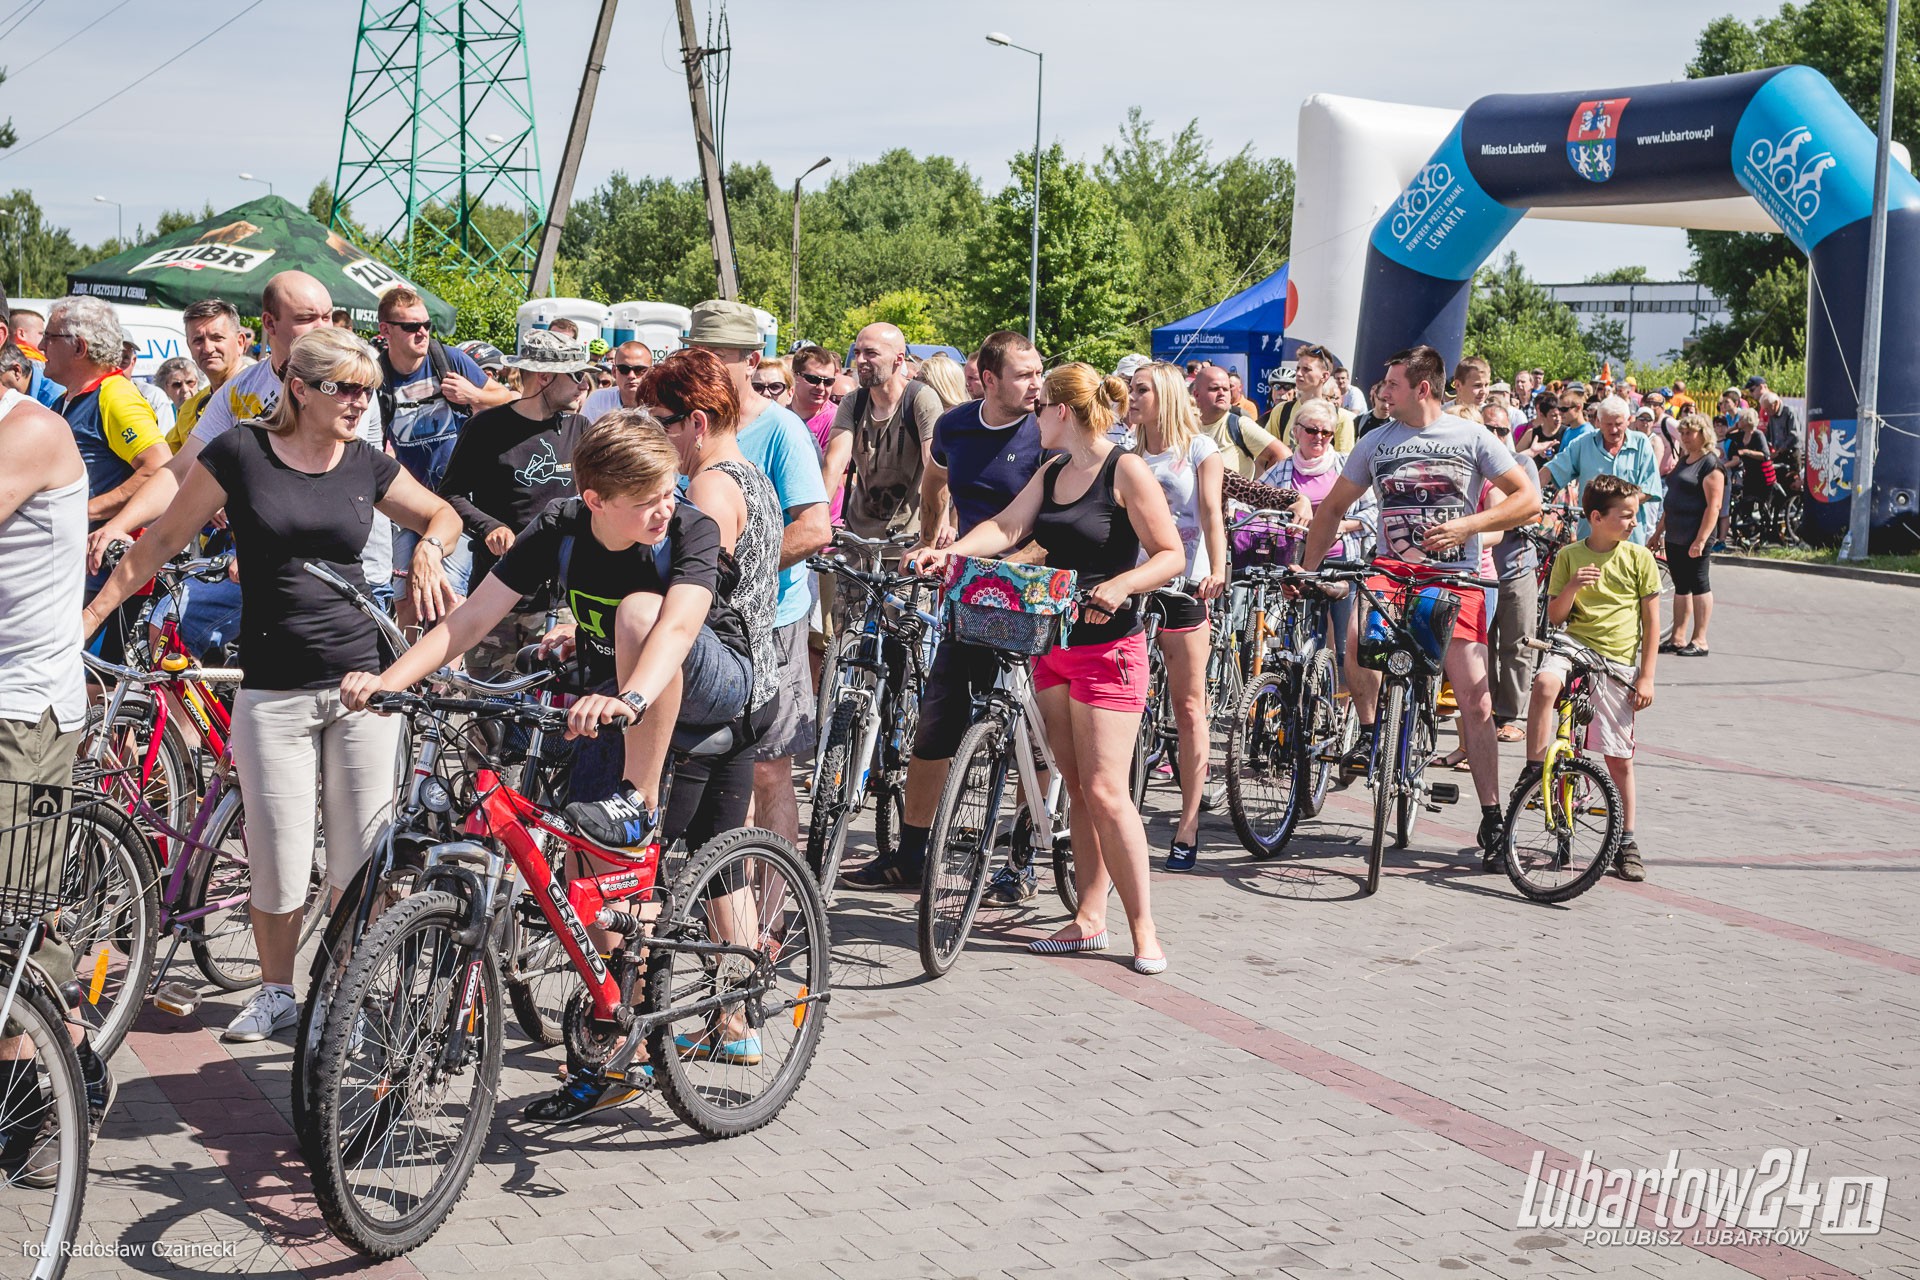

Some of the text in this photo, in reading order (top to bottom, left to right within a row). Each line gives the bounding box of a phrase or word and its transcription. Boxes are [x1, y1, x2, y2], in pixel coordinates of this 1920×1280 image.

[1481, 141, 1547, 155] Miasto Lubartów
[1637, 125, 1714, 146] www.lubartow.pl
[1405, 223, 1432, 252] ROWEREM
[1428, 205, 1446, 226] PRZEZ
[1425, 206, 1467, 250] LEWARTA
[121, 286, 128, 297] W
[121, 427, 135, 440] SR
[184, 698, 210, 731] GRAND
[548, 882, 607, 977] GRAND
[465, 964, 479, 1007] ZOOM
